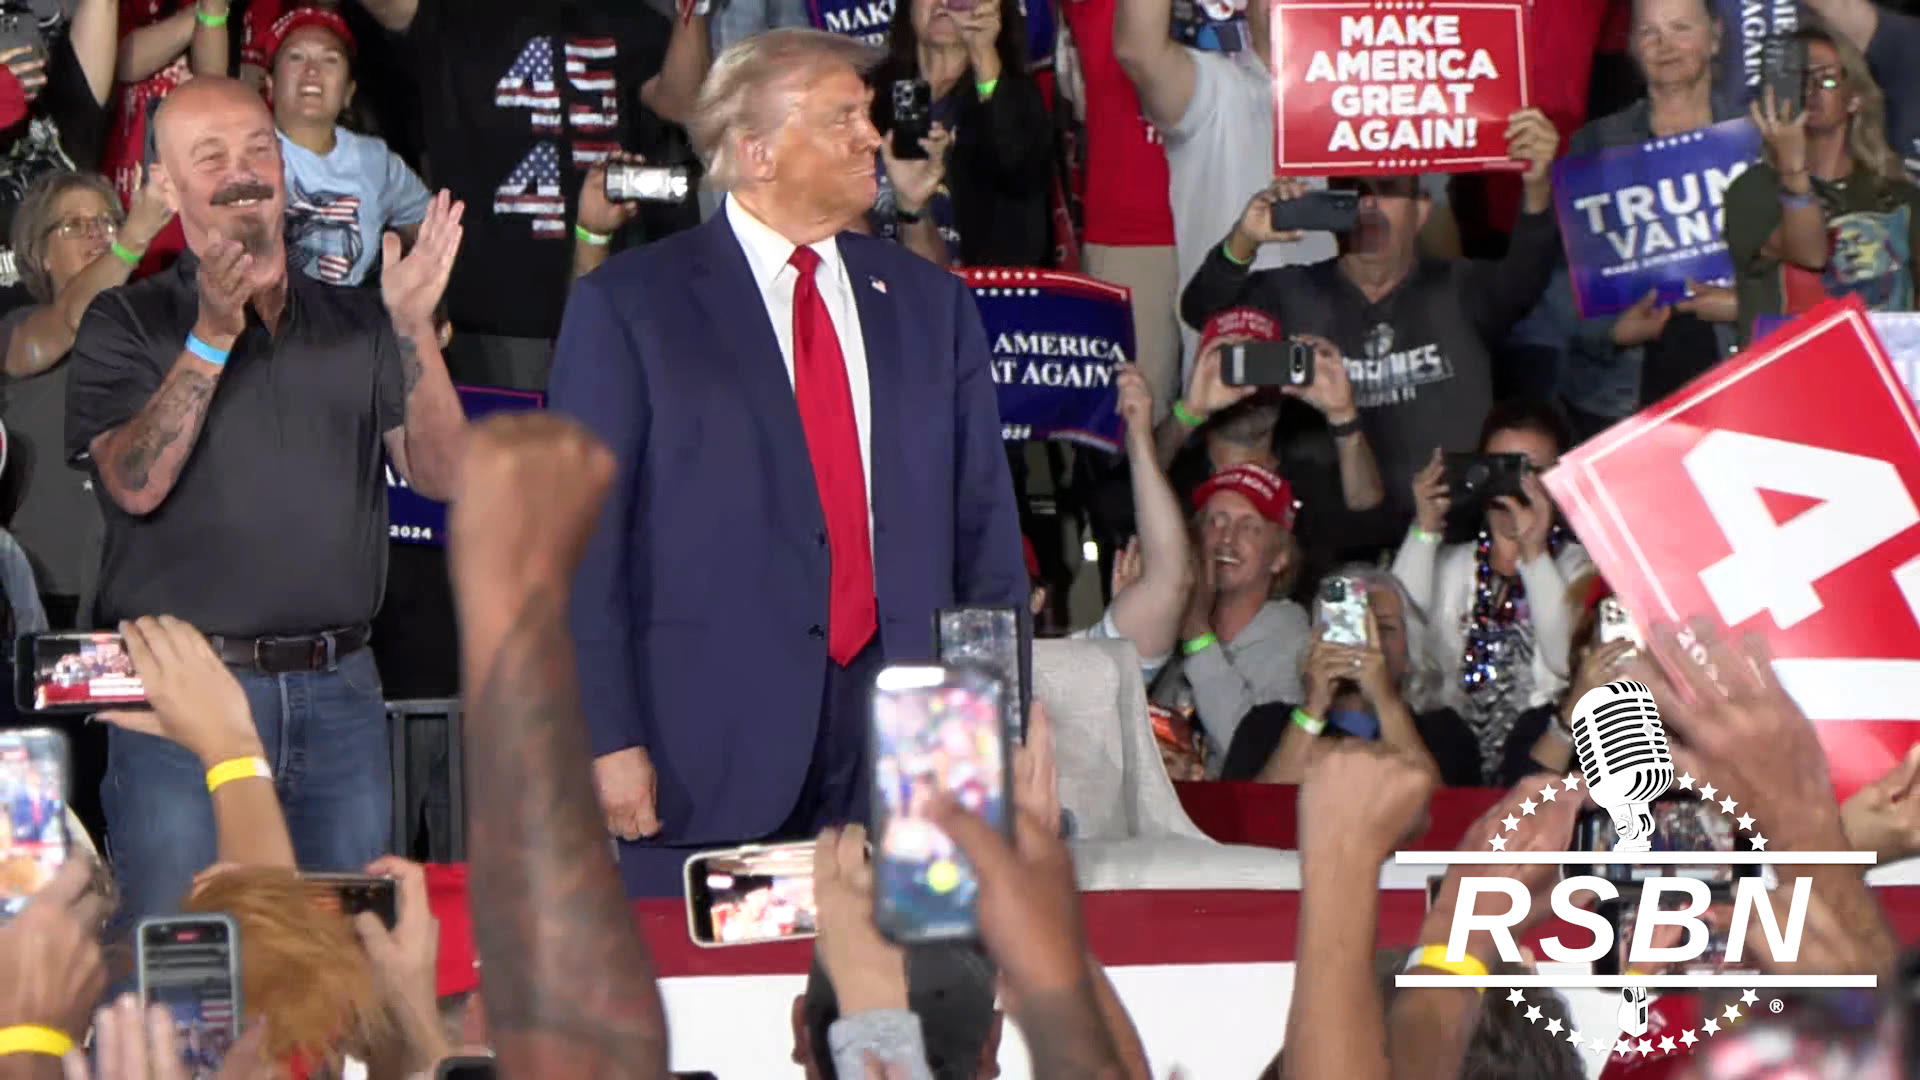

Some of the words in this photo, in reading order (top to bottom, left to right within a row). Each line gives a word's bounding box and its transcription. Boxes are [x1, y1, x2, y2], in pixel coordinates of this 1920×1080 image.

[1340, 15, 1461, 47] MAKE
[1304, 49, 1499, 82] AMERICA
[1331, 83, 1474, 117] GREAT
[1328, 118, 1478, 152] AGAIN!
[993, 330, 1127, 364] AMERICA
[388, 524, 433, 541] 2024
